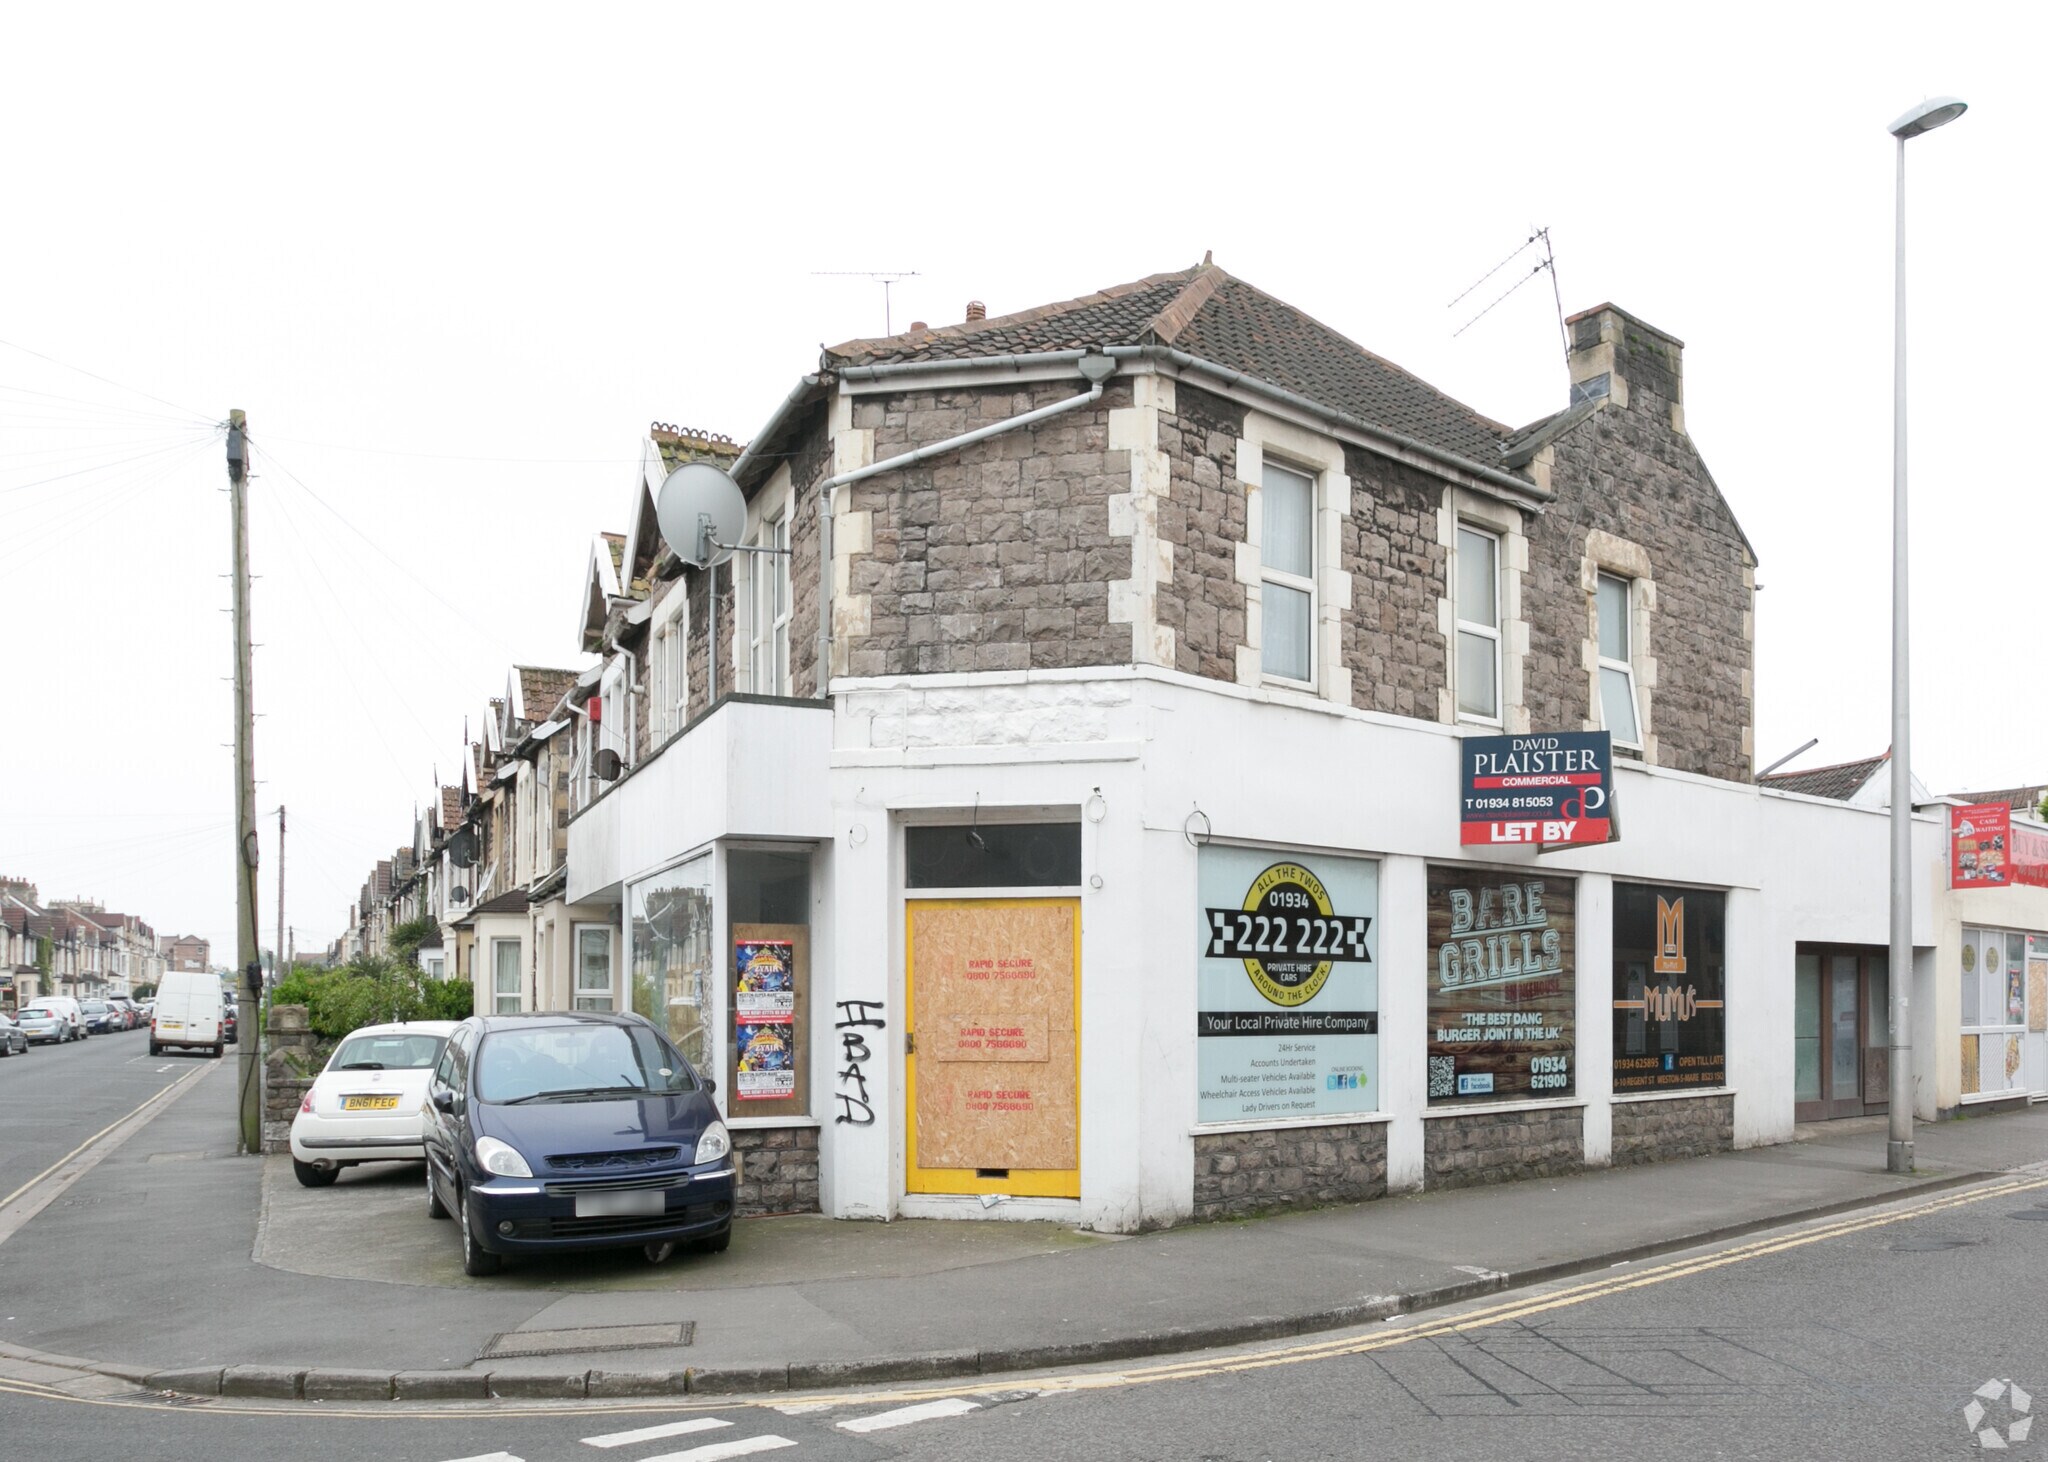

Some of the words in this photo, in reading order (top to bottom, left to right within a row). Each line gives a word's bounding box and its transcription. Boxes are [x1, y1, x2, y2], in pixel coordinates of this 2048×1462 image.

[1512, 738, 1558, 751] DAVID
[1474, 750, 1601, 774] PLAISTER
[1502, 776, 1571, 786] COMMERCIAL
[1465, 799, 1474, 809] T
[1475, 798, 1510, 808] 01934
[1512, 796, 1554, 808] 815053
[1491, 822, 1538, 842] LET
[1542, 821, 1578, 840] BY
[2012, 834, 2029, 856] BUY
[2032, 838, 2040, 857] &
[1257, 874, 1274, 894] ALL
[1276, 867, 1296, 879] THE
[1299, 871, 1326, 900] TWOS
[1269, 891, 1310, 908] 01934
[1449, 881, 1547, 933] BARE
[1236, 914, 1288, 953] 222
[1296, 918, 1344, 955] 222
[968, 960, 994, 968] RAPID
[998, 959, 1034, 968] SECURE
[1438, 928, 1561, 986] GRILLS
[1267, 962, 1296, 972] PRIVATE
[1296, 964, 1312, 973] HIRE
[966, 971, 990, 980] 0800
[1280, 973, 1298, 982] CARS
[1254, 968, 1285, 1000] AROUND
[1287, 990, 1304, 1000] THE
[1304, 968, 1326, 994] CLOCK
[1207, 1016, 1233, 1030] Your
[1235, 1016, 1262, 1030] Local
[1264, 1015, 1300, 1029] Private
[1302, 1015, 1322, 1028] Hire
[1324, 1015, 1370, 1031] Company
[1488, 1013, 1512, 1026] BEST
[1514, 1012, 1542, 1025] DANG
[960, 1028, 985, 1036] RAPID
[989, 1028, 1024, 1036] SECURE
[1437, 1028, 1481, 1042] BURGER
[1483, 1028, 1512, 1041] JOINT
[1514, 1028, 1524, 1040] IN
[1525, 1028, 1545, 1040] THE
[958, 1040, 982, 1048] 0800
[1278, 1044, 1293, 1052] 24Hr
[1294, 1043, 1316, 1052] Service
[1250, 1059, 1279, 1068] Accounts
[1280, 1058, 1316, 1066] Undertaken
[1530, 1056, 1567, 1074] 01934
[1614, 1059, 1634, 1069] 01934
[1679, 1057, 1696, 1067] OPEN
[1696, 1056, 1709, 1066] TILL
[1710, 1055, 1724, 1065] LATE
[1220, 1074, 1260, 1084] Multi-seater
[1261, 1073, 1287, 1082] Vehicles
[1288, 1072, 1316, 1081] Available
[1530, 1074, 1567, 1089] 621900
[1626, 1076, 1648, 1086] REGENT
[1648, 1076, 1655, 1084] ST
[1702, 1072, 1714, 1081] BS23
[968, 1090, 992, 1098] RAPID
[996, 1090, 1032, 1099] SECURE
[1200, 1090, 1238, 1100] Wheelchair
[1238, 1089, 1260, 1098] Access
[1261, 1088, 1287, 1096] Vehicles
[1288, 1086, 1316, 1096] Available
[349, 1098, 372, 1108] BN61
[373, 1097, 396, 1107] FEG
[966, 1102, 988, 1110] 0800
[1242, 1104, 1257, 1113] Lady
[1258, 1103, 1280, 1112] Drivers
[1282, 1102, 1290, 1110] on
[1290, 1100, 1316, 1110] Request
